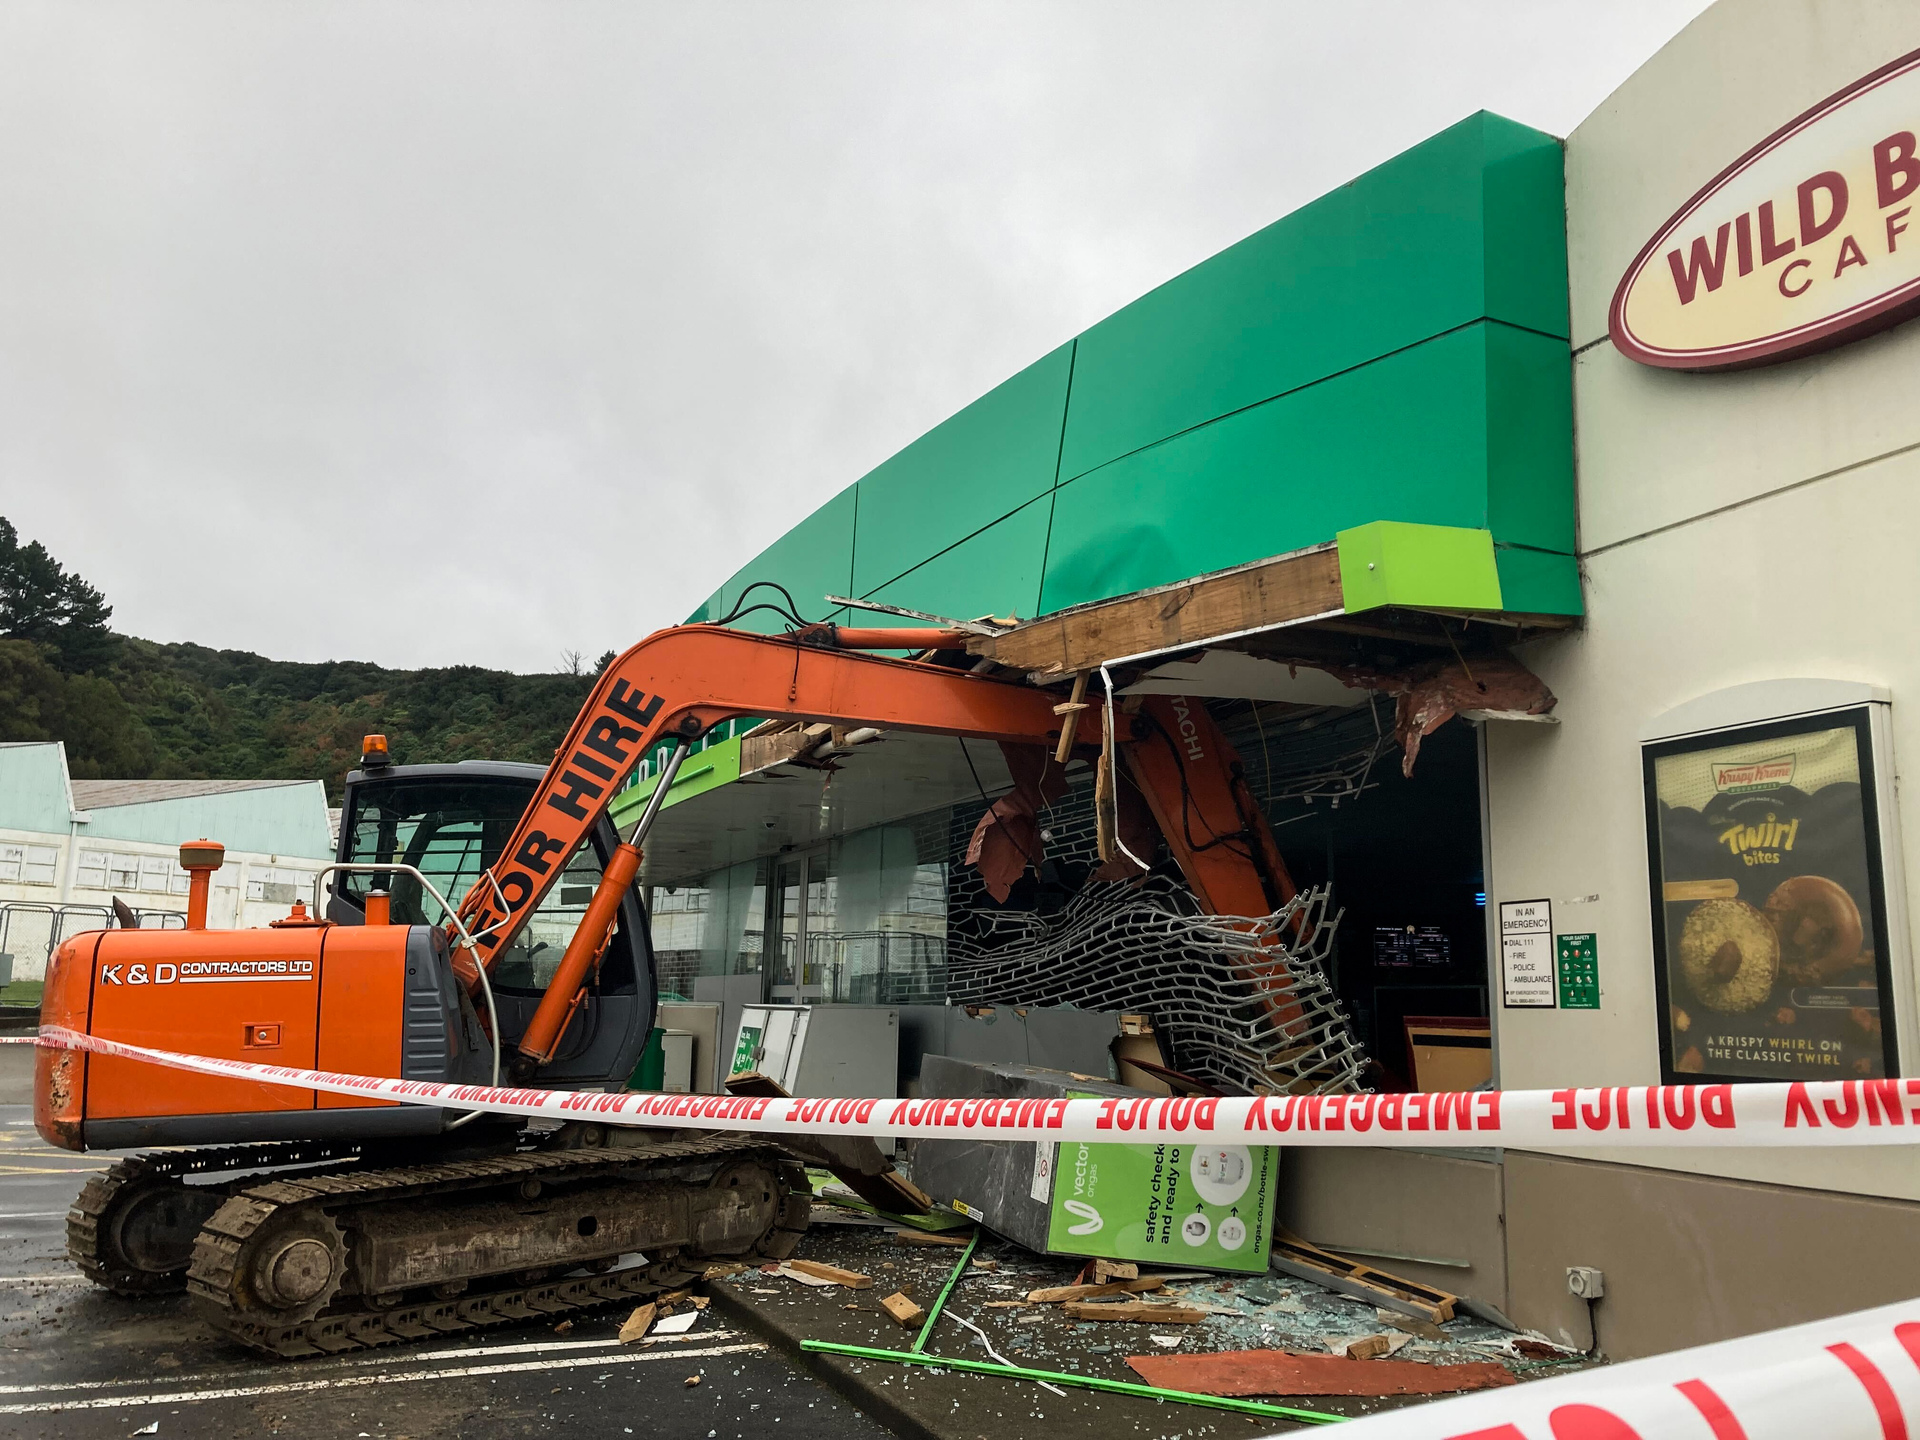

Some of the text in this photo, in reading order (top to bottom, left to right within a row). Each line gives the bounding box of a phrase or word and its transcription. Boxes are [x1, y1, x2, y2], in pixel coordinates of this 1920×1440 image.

[1667, 170, 1849, 306] WILD
[1778, 205, 1914, 298] CAF
[1171, 695, 1204, 760] TACHI
[1718, 762, 1792, 786] Krispy Kreme
[473, 677, 666, 950] FOR HIRE
[1719, 812, 1799, 854] Twirl
[1743, 850, 1780, 866] bites
[1503, 919, 1548, 929] EMERGENCY
[1516, 908, 1535, 917] IN AN
[101, 960, 313, 986] K & D CONTRACTORS LTD
[1514, 975, 1552, 983] AMBULANCE
[1707, 1036, 1842, 1051] A KRISPY WHIRL ON
[1708, 1048, 1840, 1065] THE CLASSIC TWIRL
[1074, 1142, 1089, 1196] vector
[1087, 1163, 1098, 1198] ongas
[1146, 1144, 1166, 1243] safety check
[1161, 1148, 1180, 1244] and ready to
